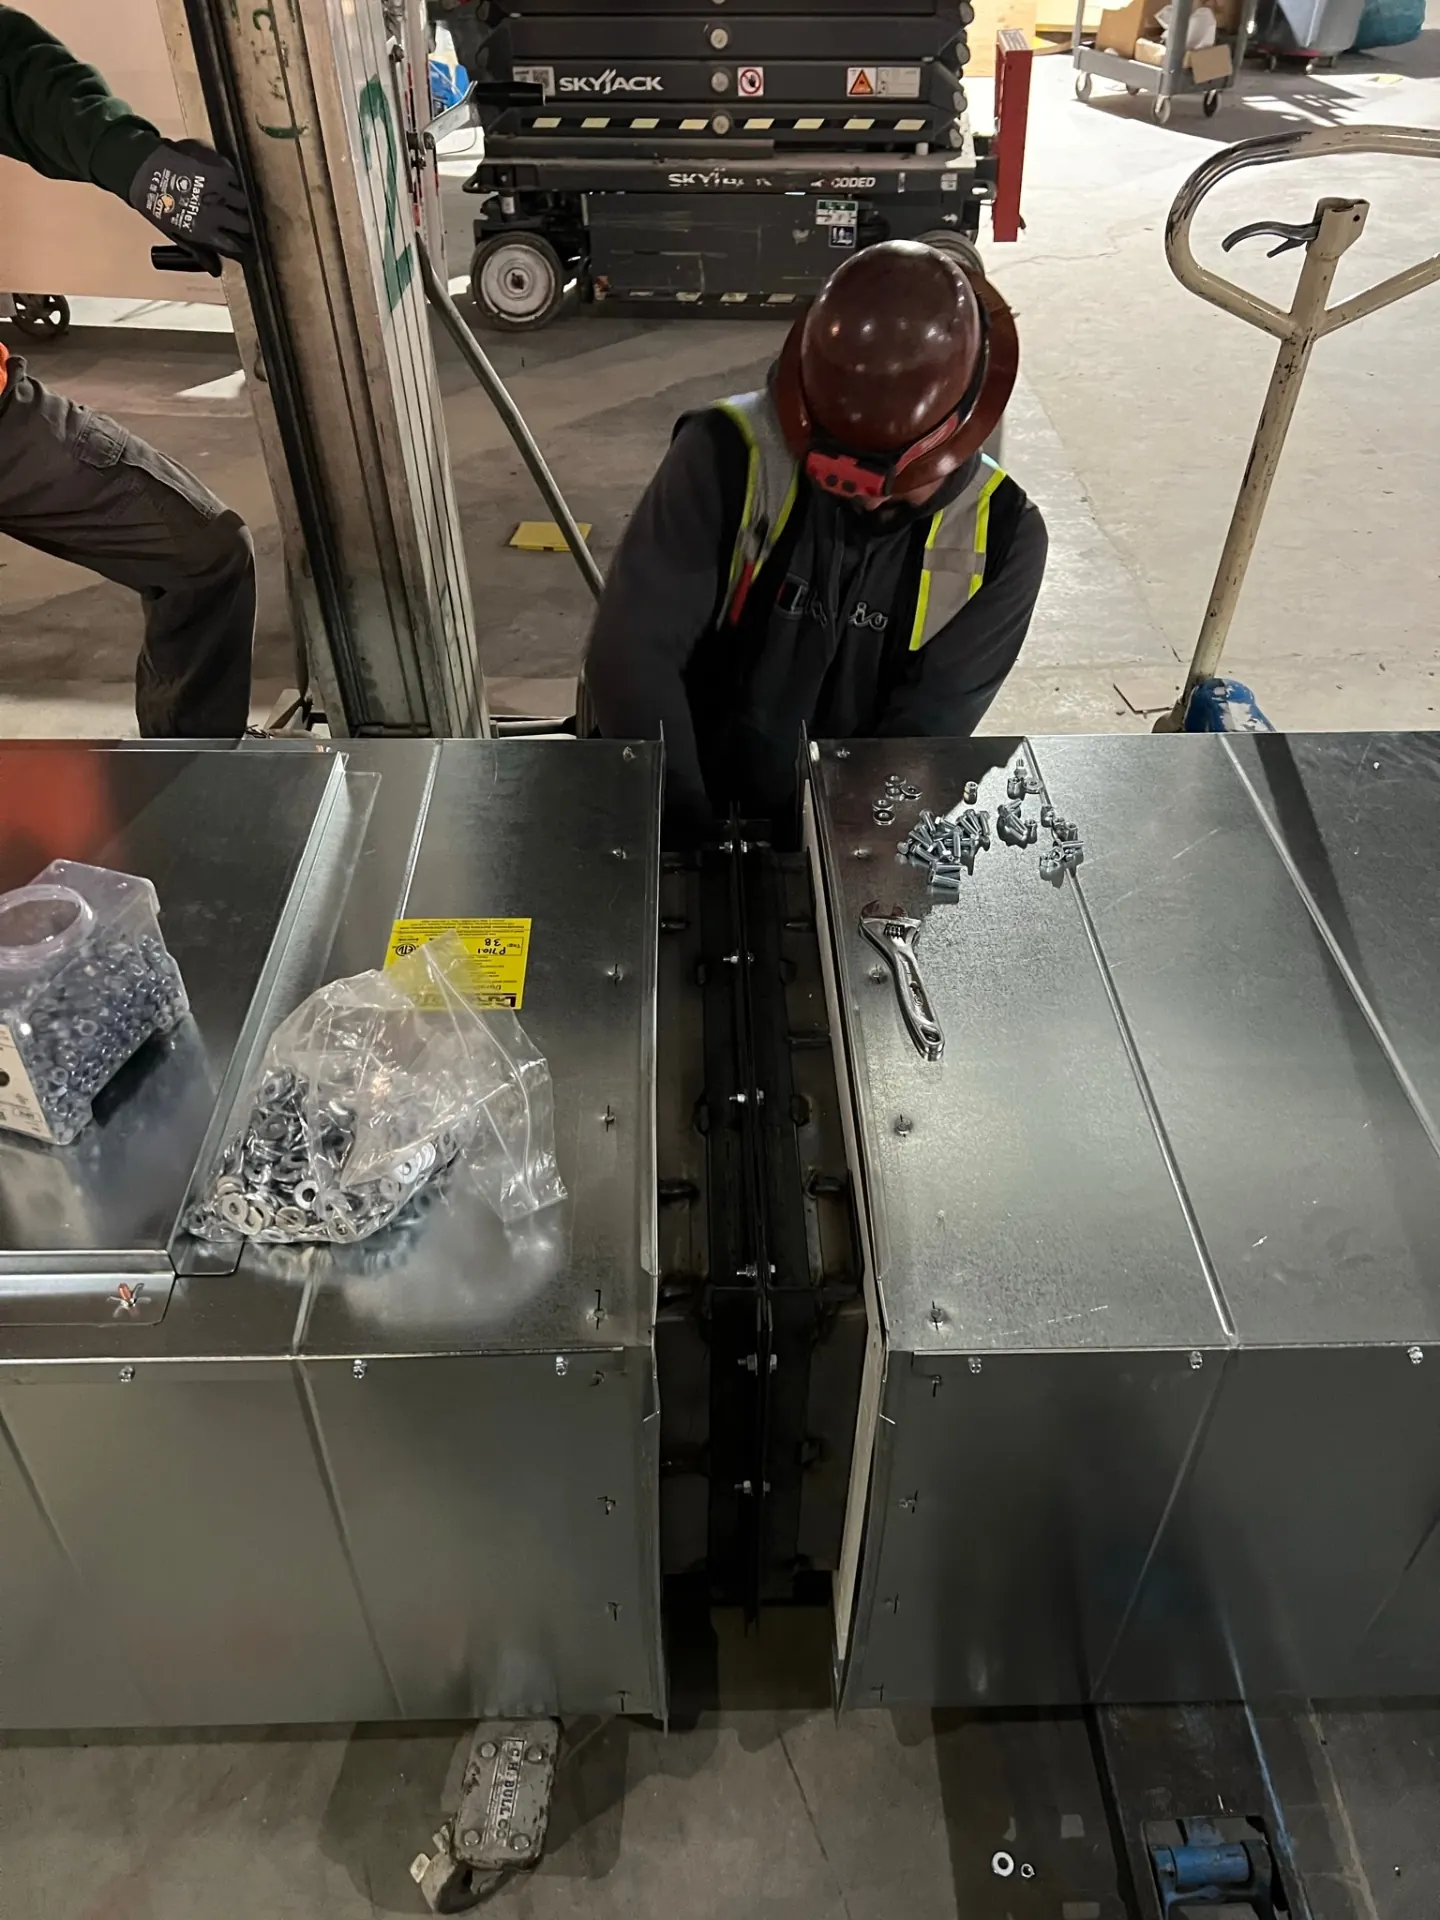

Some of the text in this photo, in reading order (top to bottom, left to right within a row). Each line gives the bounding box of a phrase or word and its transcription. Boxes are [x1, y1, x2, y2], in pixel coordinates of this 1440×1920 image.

[559, 68, 664, 94] SKYJACK
[830, 177, 876, 188] CODED
[182, 175, 205, 229] MaxiFlex
[502, 1780, 514, 1815] BULL
